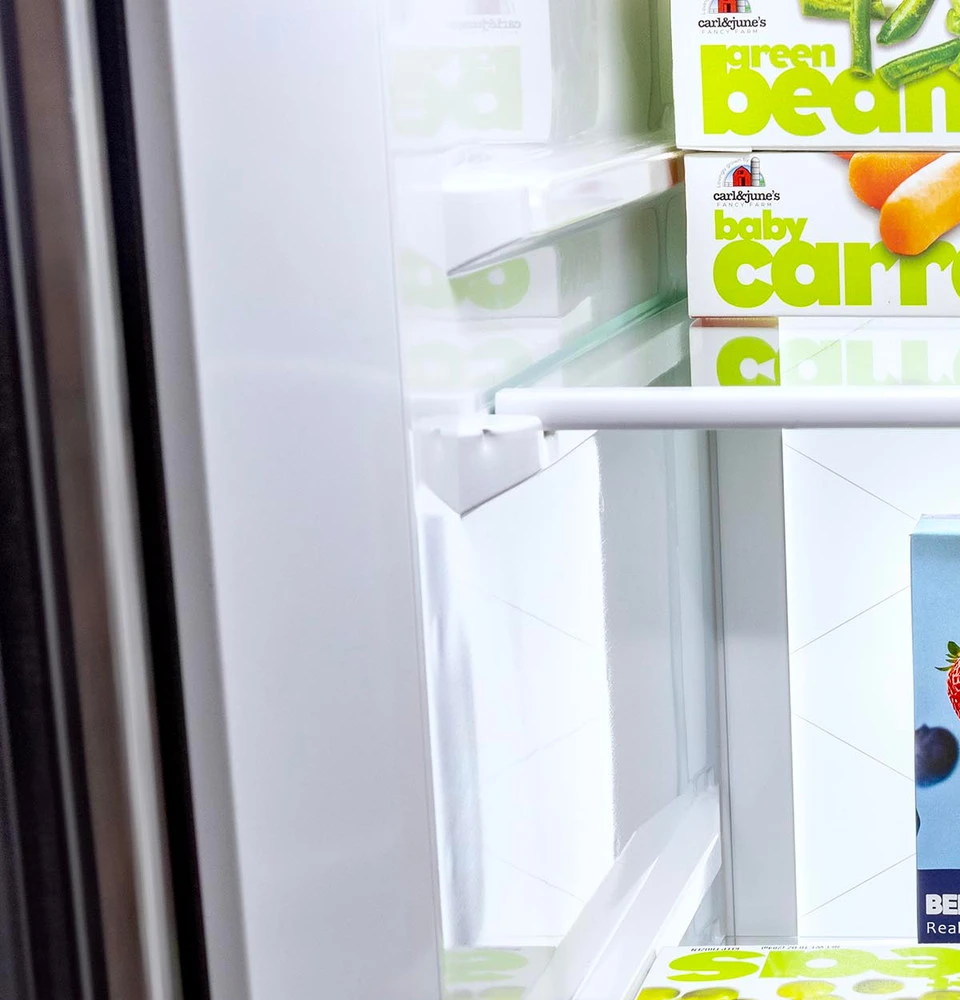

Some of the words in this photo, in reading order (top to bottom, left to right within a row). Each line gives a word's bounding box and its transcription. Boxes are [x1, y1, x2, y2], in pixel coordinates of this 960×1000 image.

[698, 16, 767, 31] carl&june's
[726, 43, 836, 75] green
[713, 190, 780, 203] carl&june's
[714, 209, 808, 242] baby
[926, 921, 960, 934] Real
